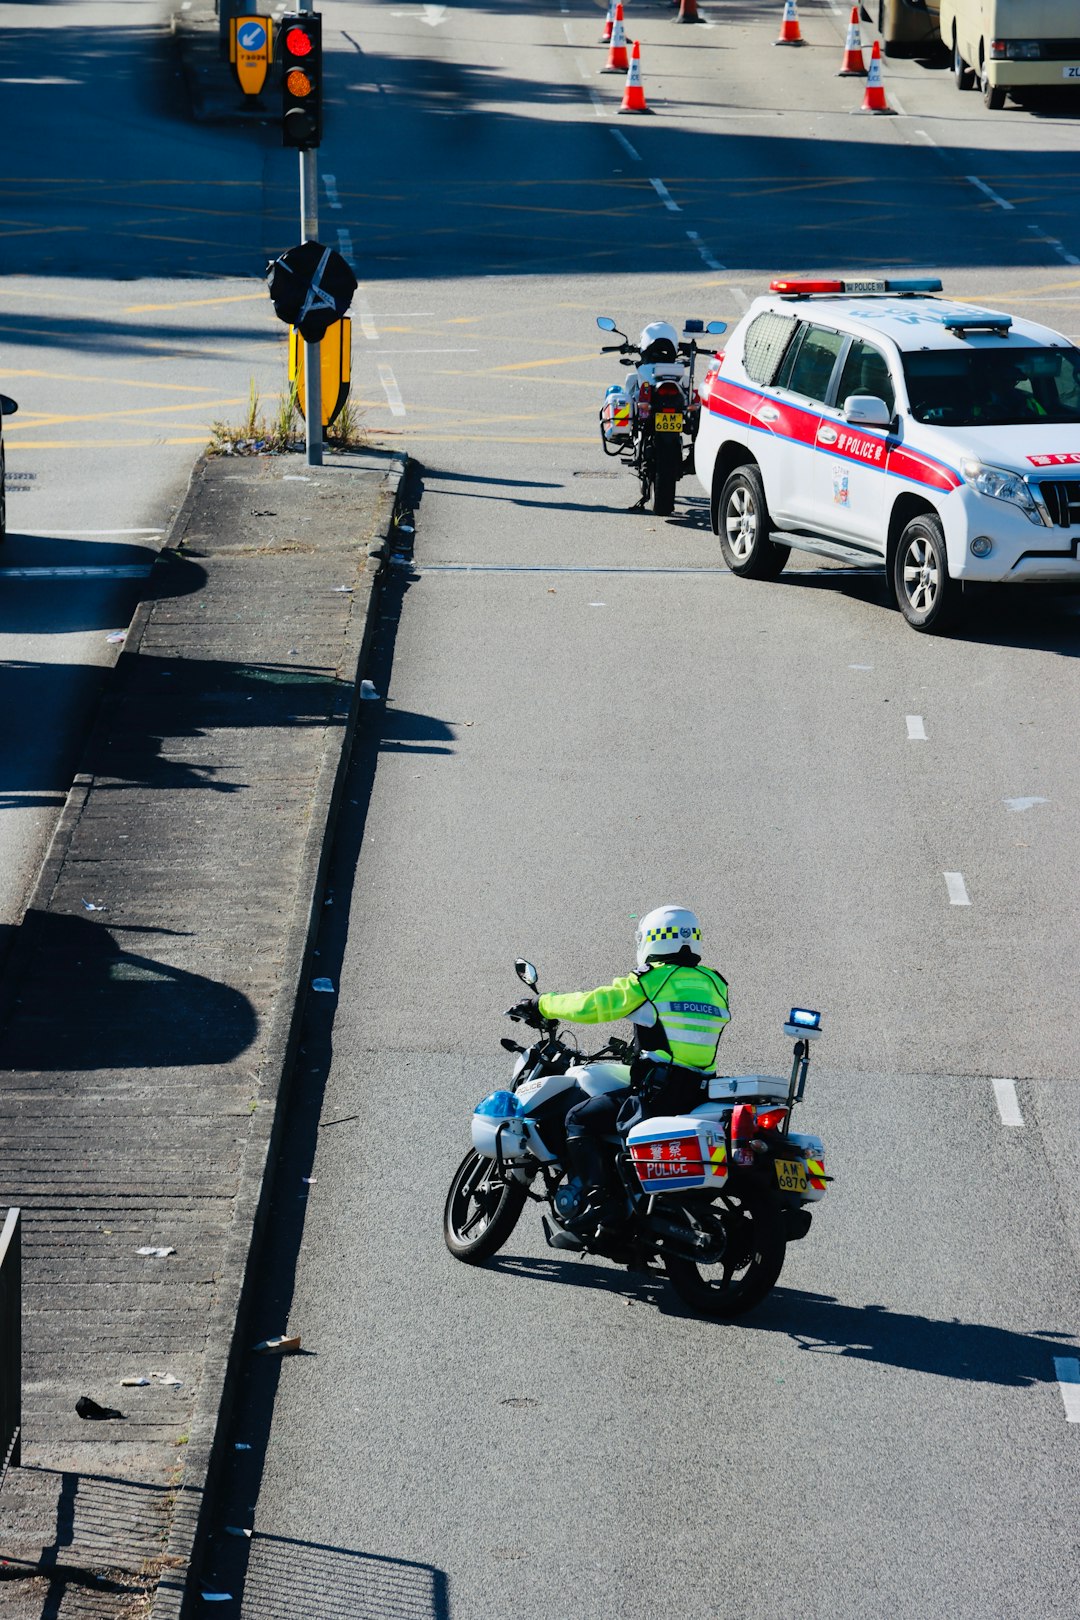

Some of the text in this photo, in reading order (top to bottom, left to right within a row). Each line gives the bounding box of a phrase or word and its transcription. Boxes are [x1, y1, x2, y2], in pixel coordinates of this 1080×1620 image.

[854, 282, 876, 291] POLICE
[662, 414, 677, 422] AM
[656, 422, 682, 430] 6859
[845, 436, 876, 459] POLICE
[683, 1003, 713, 1014] POLICE
[647, 1156, 688, 1178] POLICE
[783, 1163, 799, 1176] AM
[779, 1175, 807, 1190] 6870
